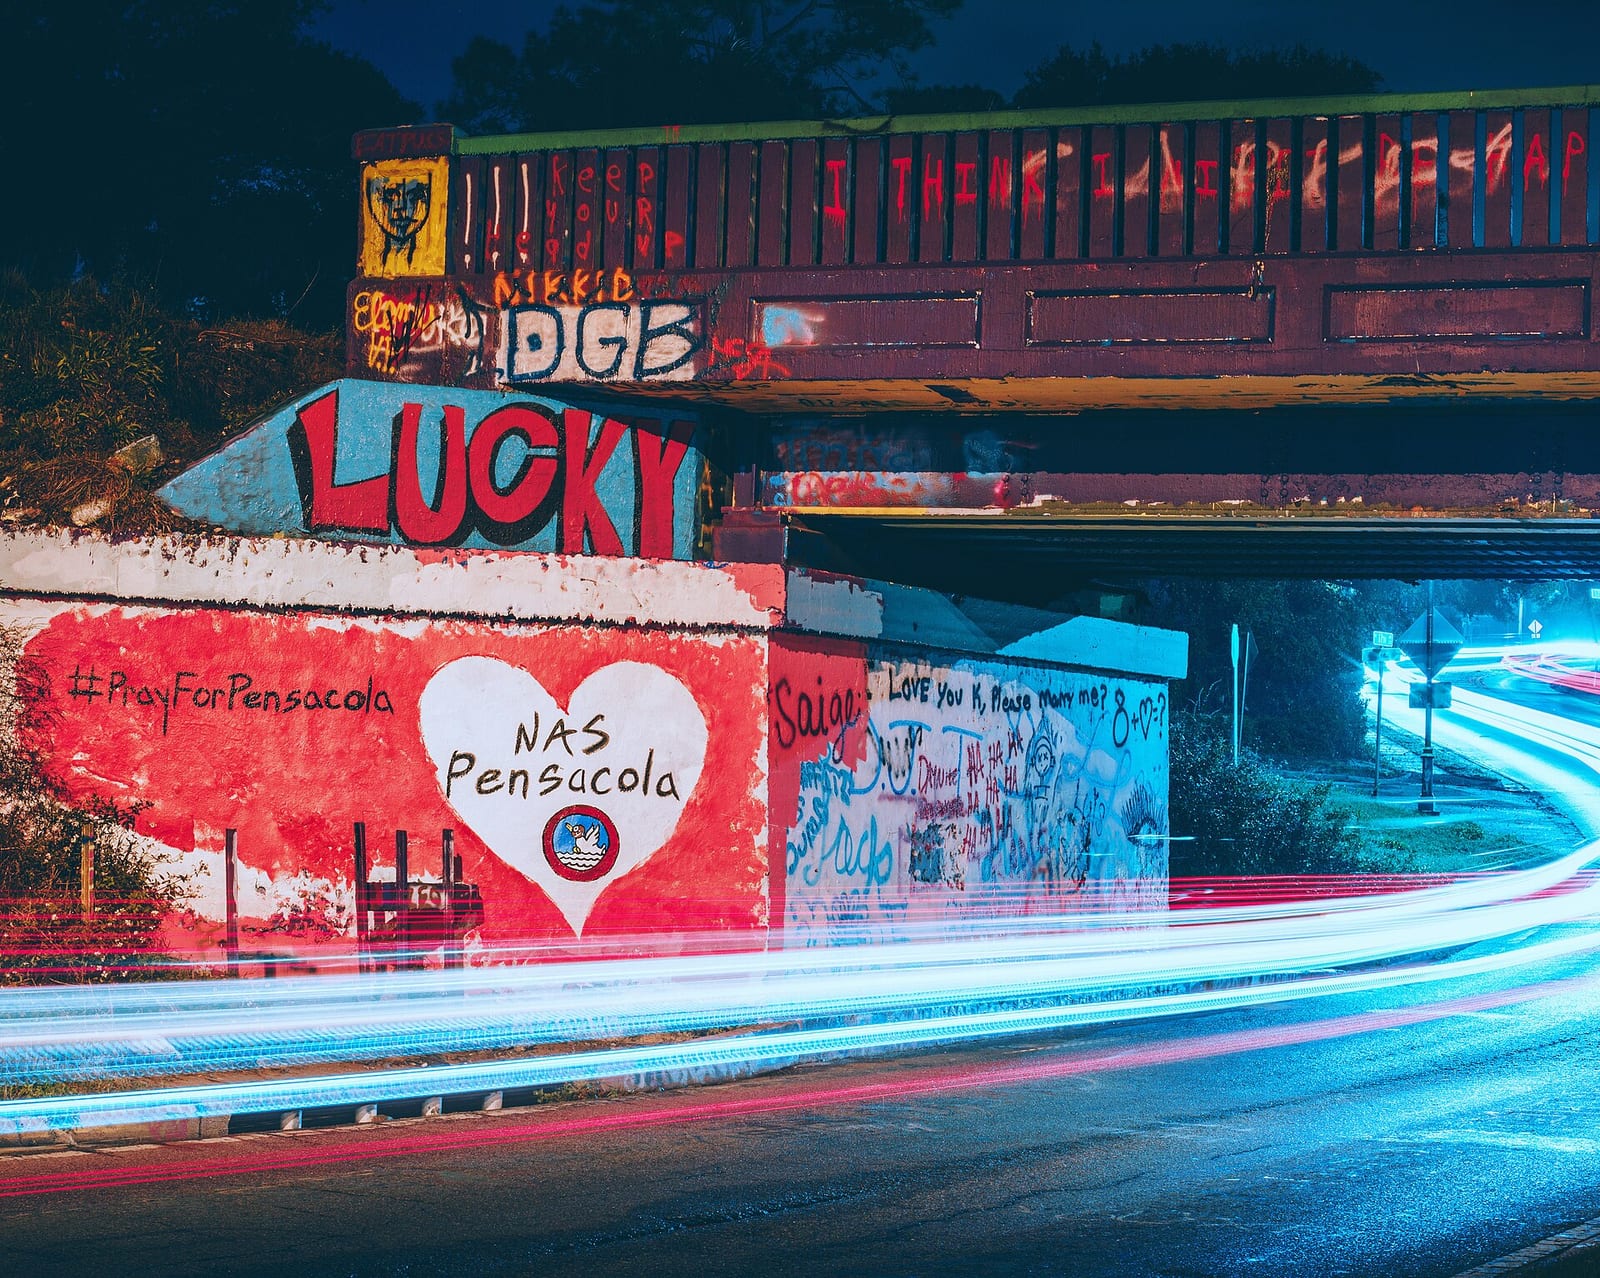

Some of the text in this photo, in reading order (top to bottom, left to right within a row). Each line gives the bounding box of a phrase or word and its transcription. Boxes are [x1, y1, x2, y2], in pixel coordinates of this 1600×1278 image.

[892, 152, 1043, 229] THINK
[504, 302, 704, 382] DGB
[286, 386, 696, 561] LUCKY
[67, 663, 394, 735] #PrayForPensacola
[888, 666, 931, 703] LOVE
[1078, 683, 1108, 719] me?
[514, 710, 611, 757] NAS
[446, 748, 681, 801] Pensacola
